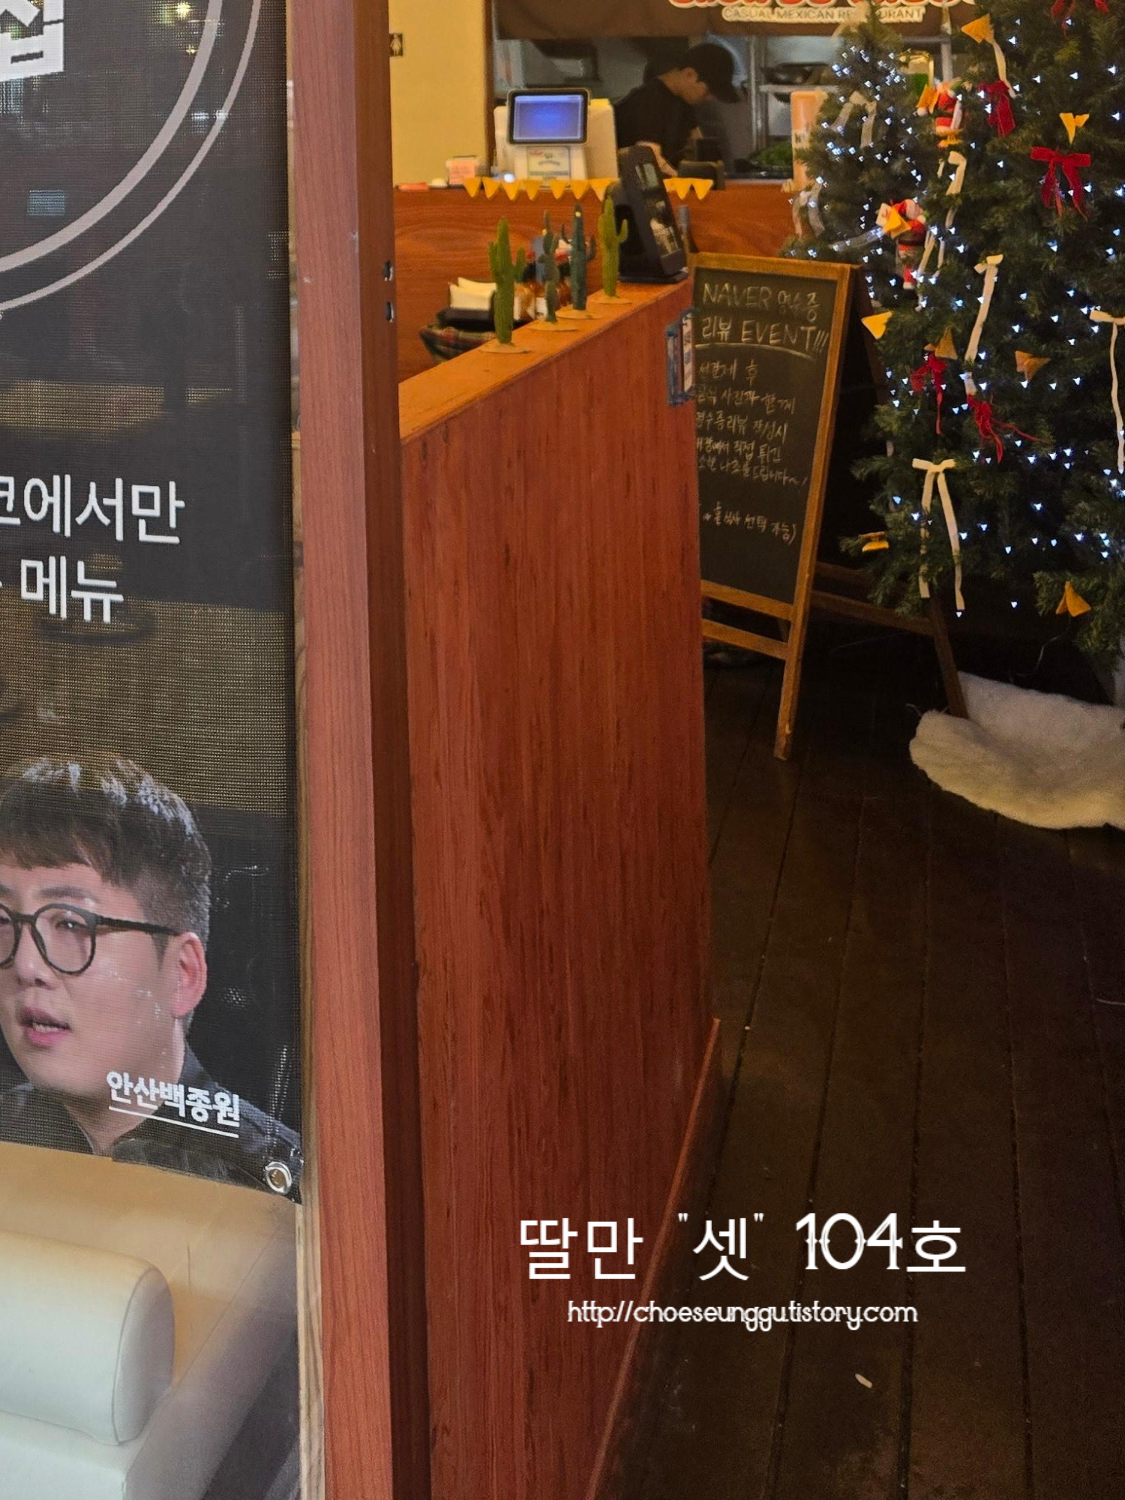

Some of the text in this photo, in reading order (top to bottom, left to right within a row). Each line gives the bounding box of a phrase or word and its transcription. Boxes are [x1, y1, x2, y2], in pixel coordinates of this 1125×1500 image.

[725, 8, 771, 19] CASUAL
[776, 8, 836, 19] MEXICAN
[703, 283, 772, 310] NAVER
[702, 316, 732, 341] 리뷰
[20, 555, 124, 623] 메뉴
[106, 1071, 240, 1128] 안산백종원
